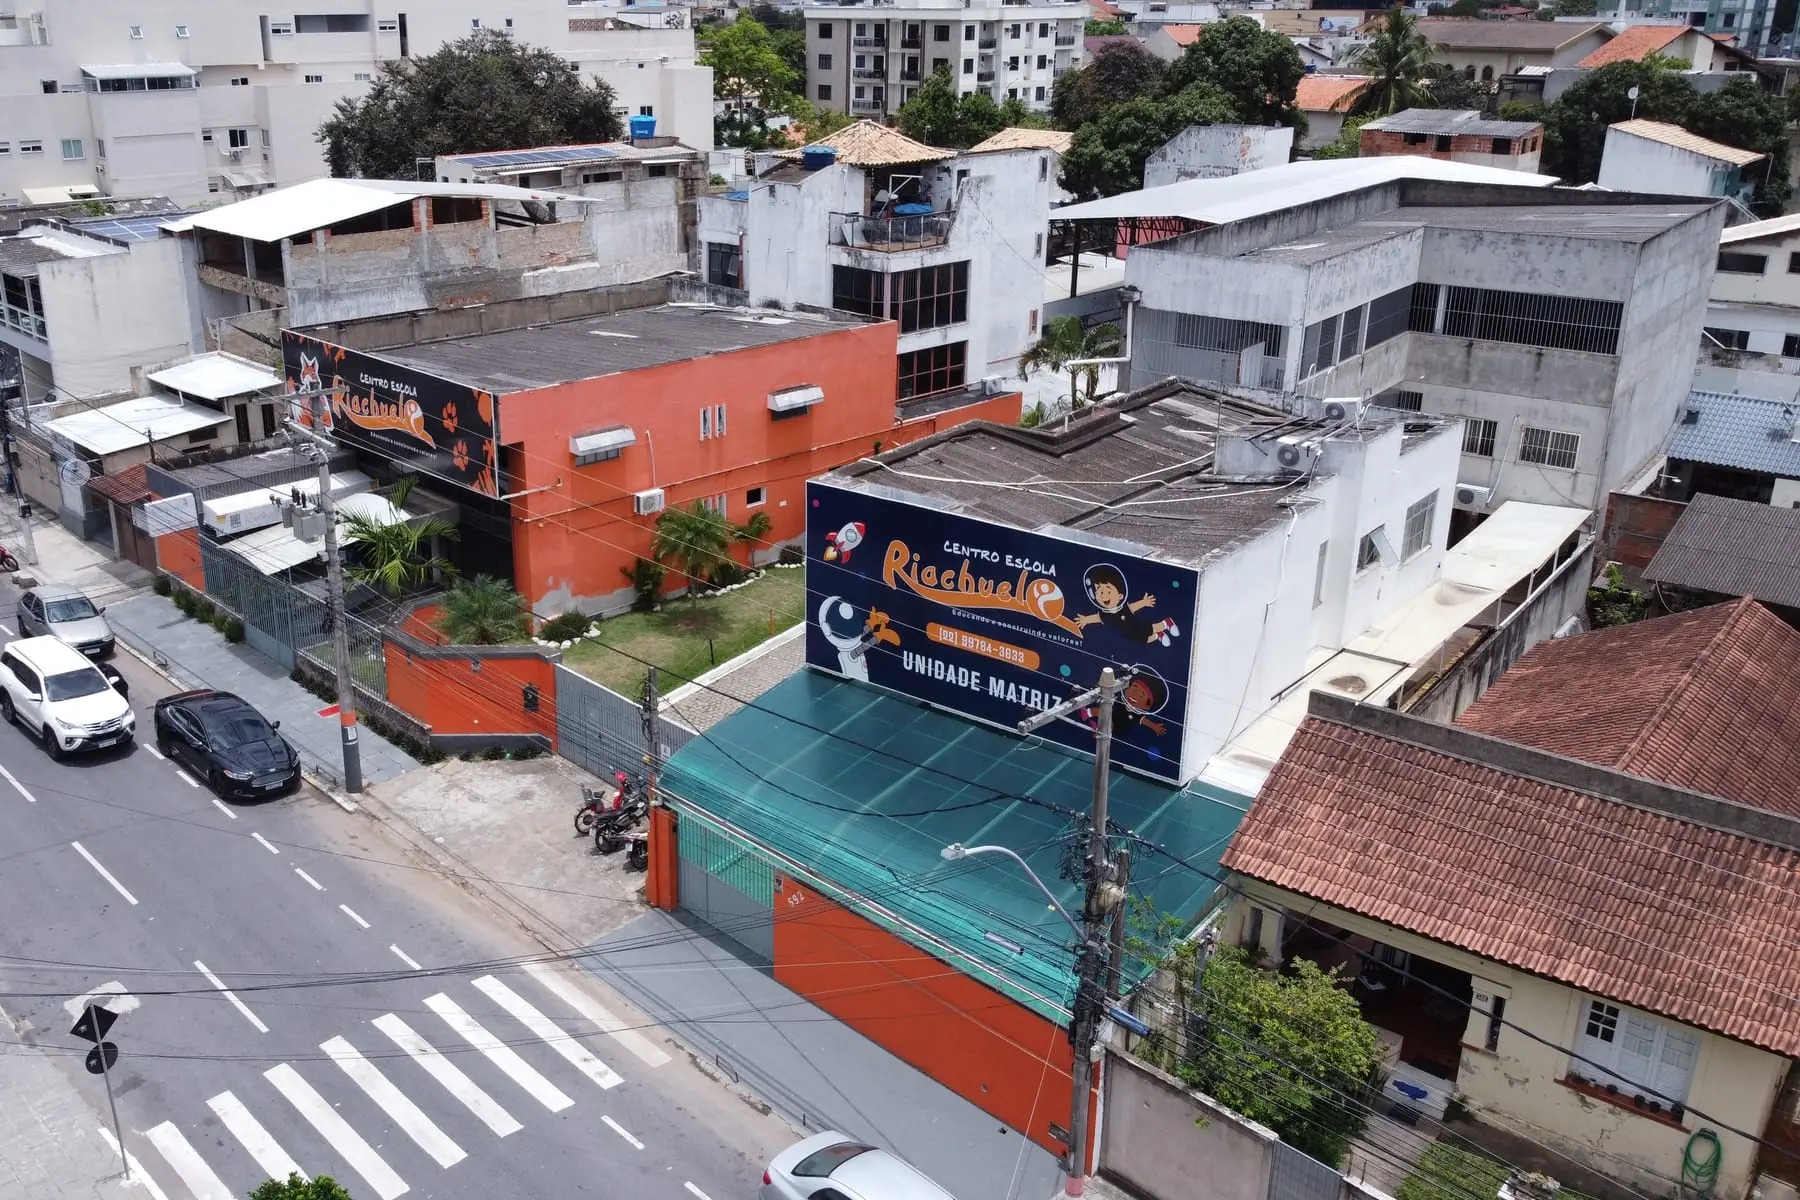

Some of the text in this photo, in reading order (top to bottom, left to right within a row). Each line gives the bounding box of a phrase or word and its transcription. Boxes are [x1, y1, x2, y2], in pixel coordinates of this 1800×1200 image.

[360, 372, 418, 398] CENTRO ESCOLA
[883, 539, 1065, 622] Riachuelo
[943, 540, 1057, 577] CENTRO ESCOLA
[903, 650, 1062, 713] UNIDADE MATRIZ
